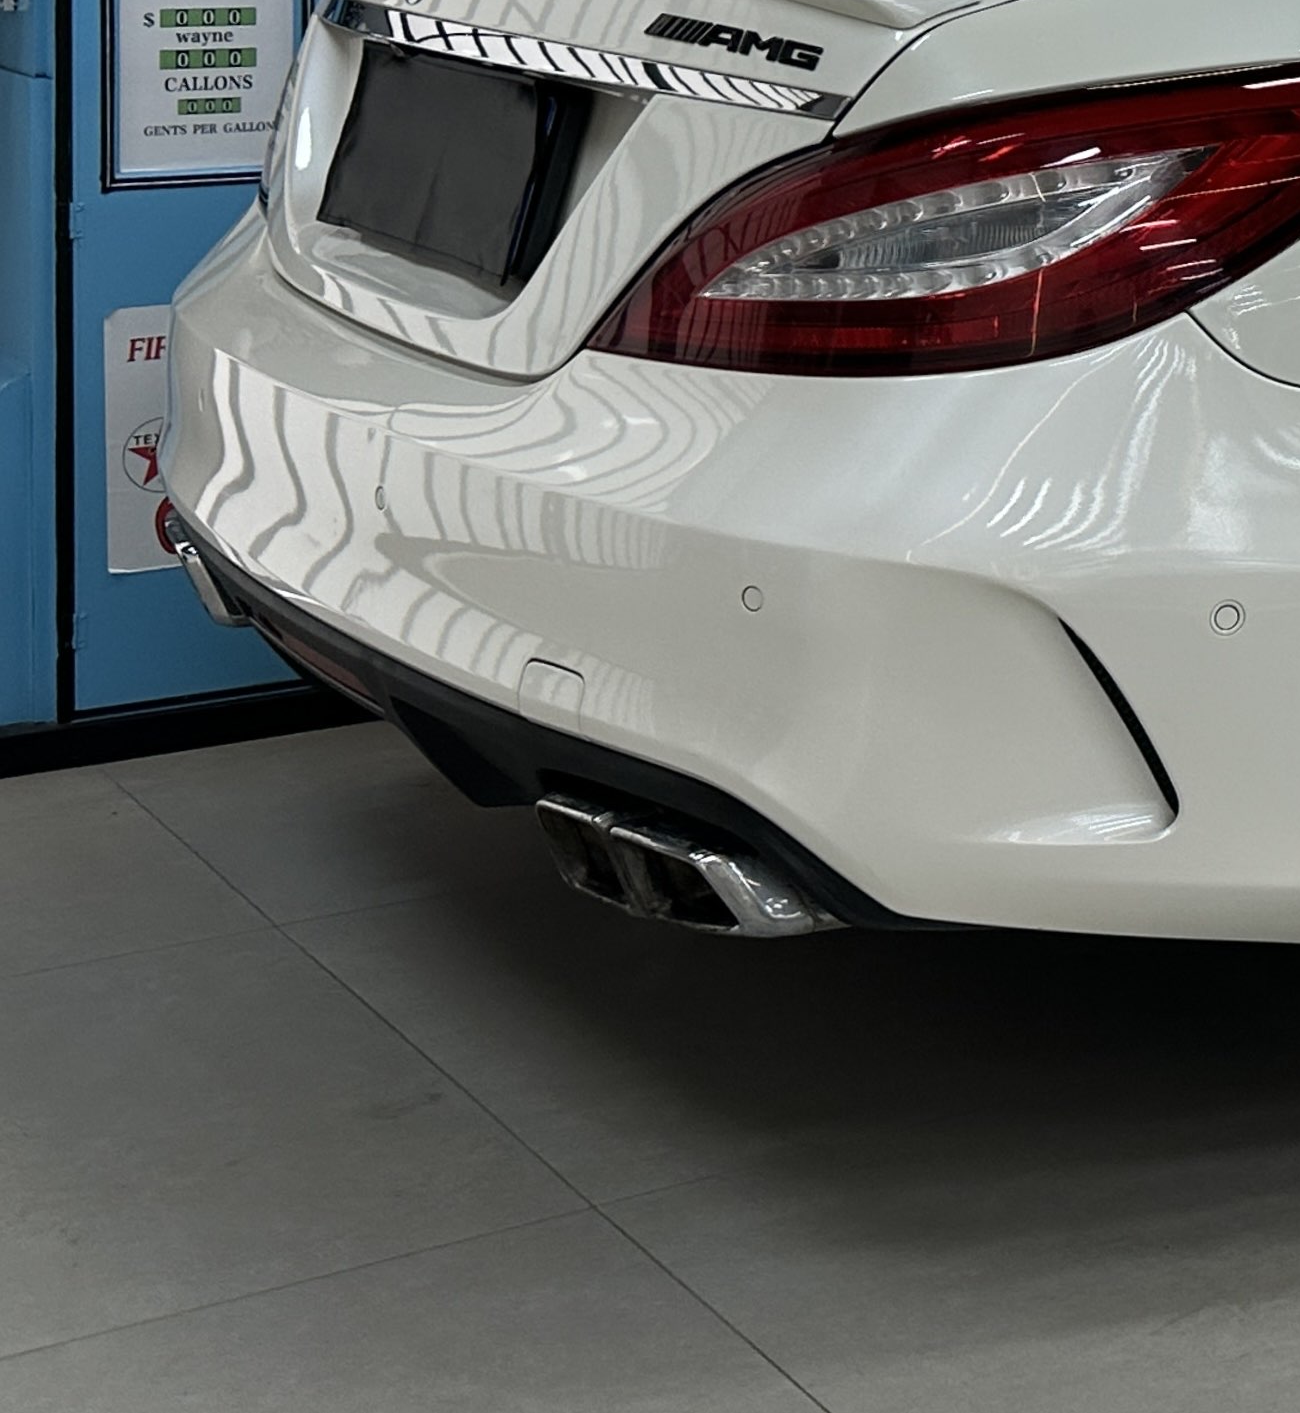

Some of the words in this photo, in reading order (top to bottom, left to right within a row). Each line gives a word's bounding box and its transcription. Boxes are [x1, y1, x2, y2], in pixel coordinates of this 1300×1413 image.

[143, 12, 155, 28] $
[176, 30, 234, 46] wayne
[698, 23, 823, 70] AMG
[192, 123, 218, 135] PER
